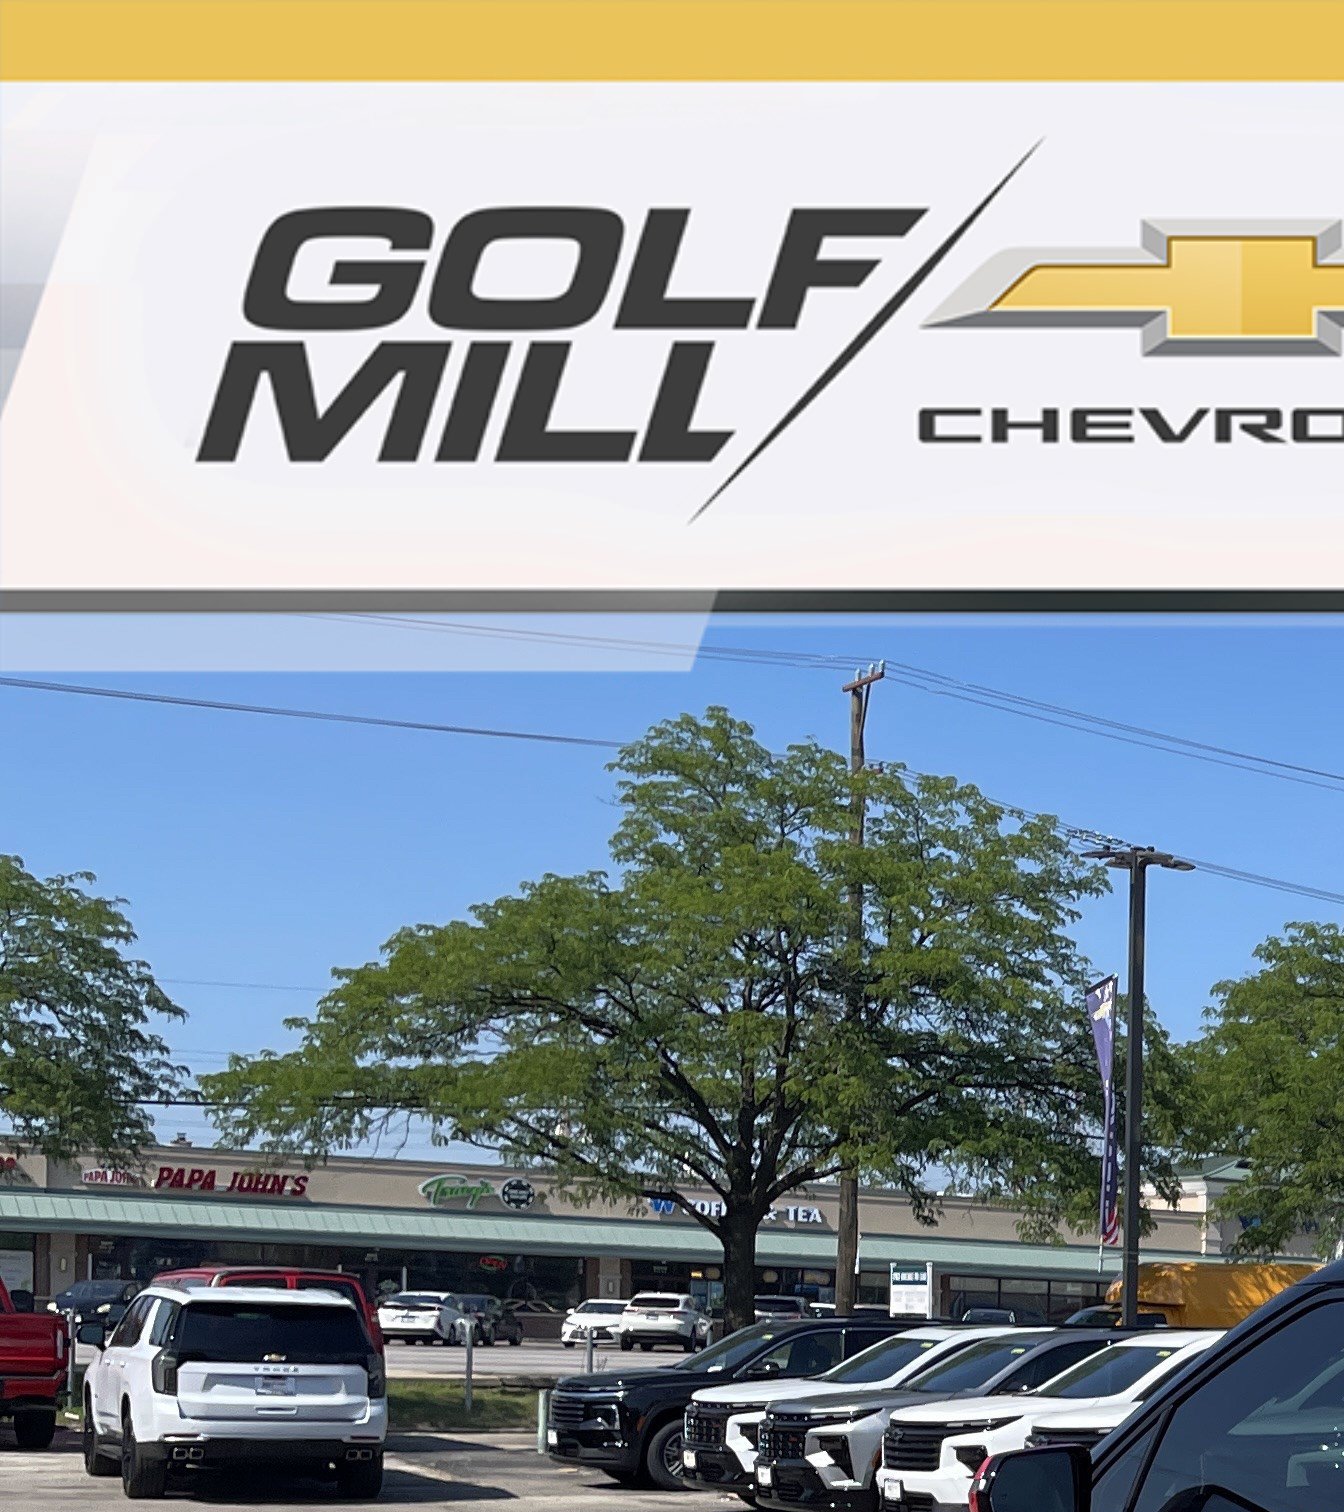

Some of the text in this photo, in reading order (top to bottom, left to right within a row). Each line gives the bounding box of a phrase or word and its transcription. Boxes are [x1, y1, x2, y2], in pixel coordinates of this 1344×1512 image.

[154, 1167, 309, 1196] PAPA JOHN'S
[785, 1205, 823, 1223] TEA
